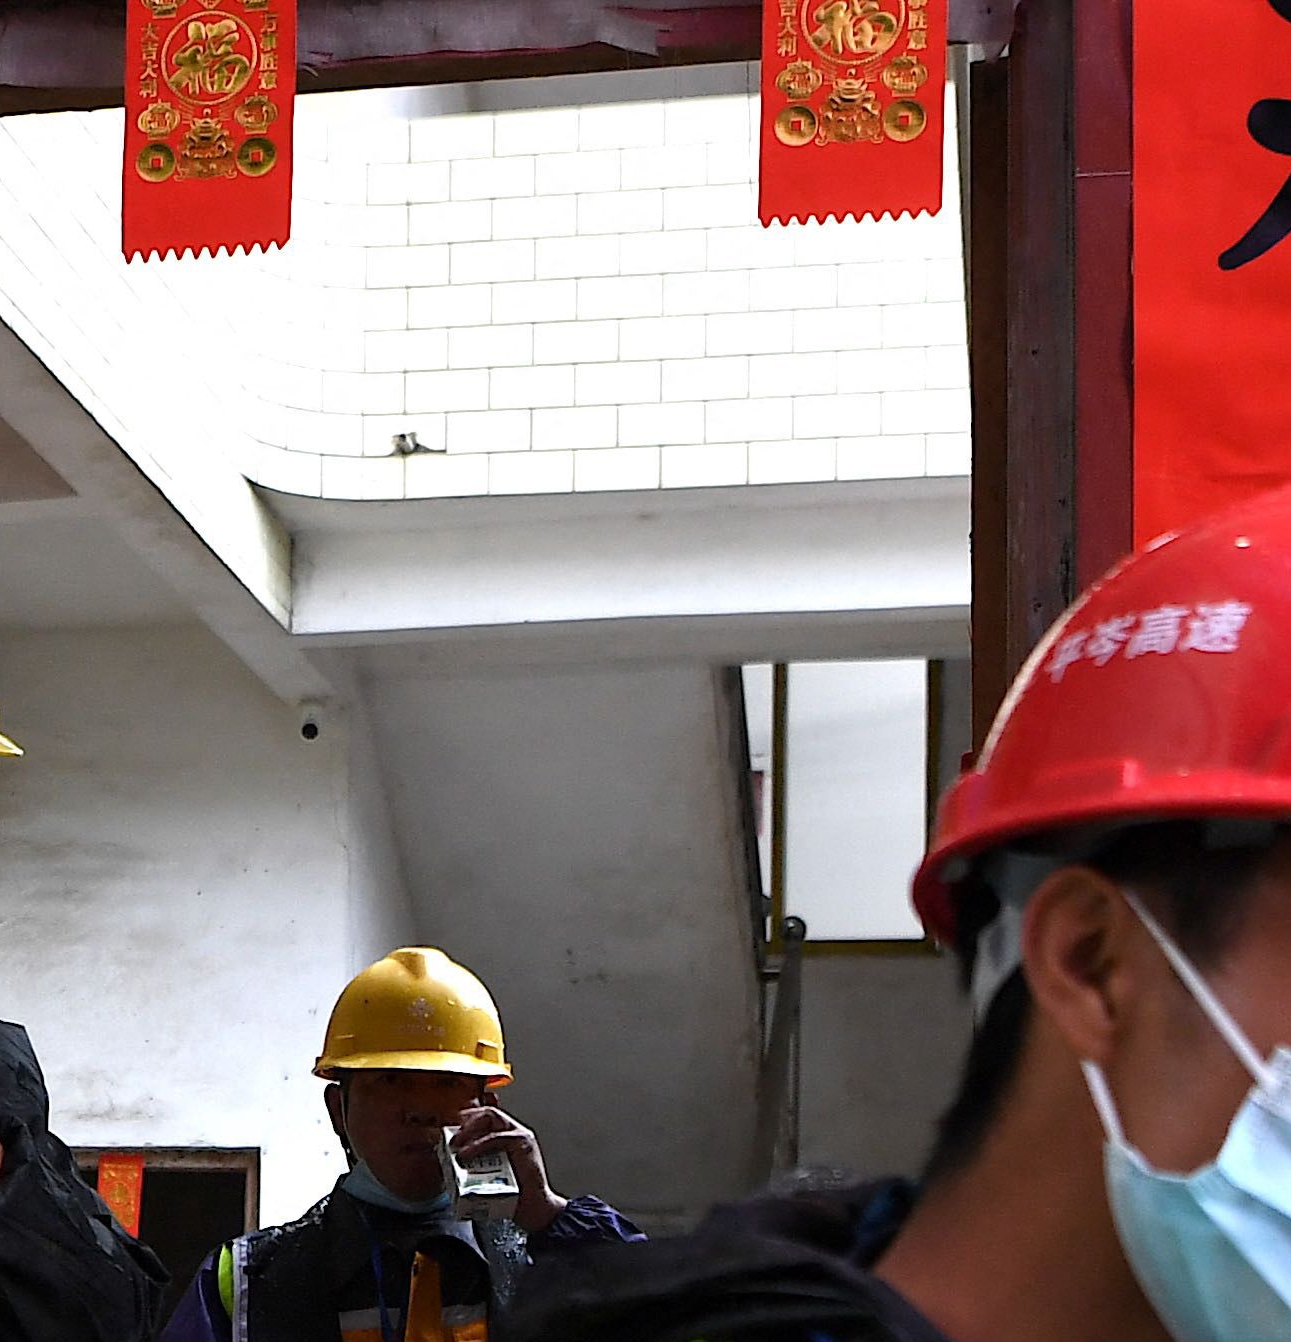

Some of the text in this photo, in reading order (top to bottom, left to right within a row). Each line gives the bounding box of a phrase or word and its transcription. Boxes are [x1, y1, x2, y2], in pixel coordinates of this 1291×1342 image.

[139, 22, 159, 98] 大吉大利
[169, 19, 250, 95] 福
[258, 13, 279, 90] 万事胜意
